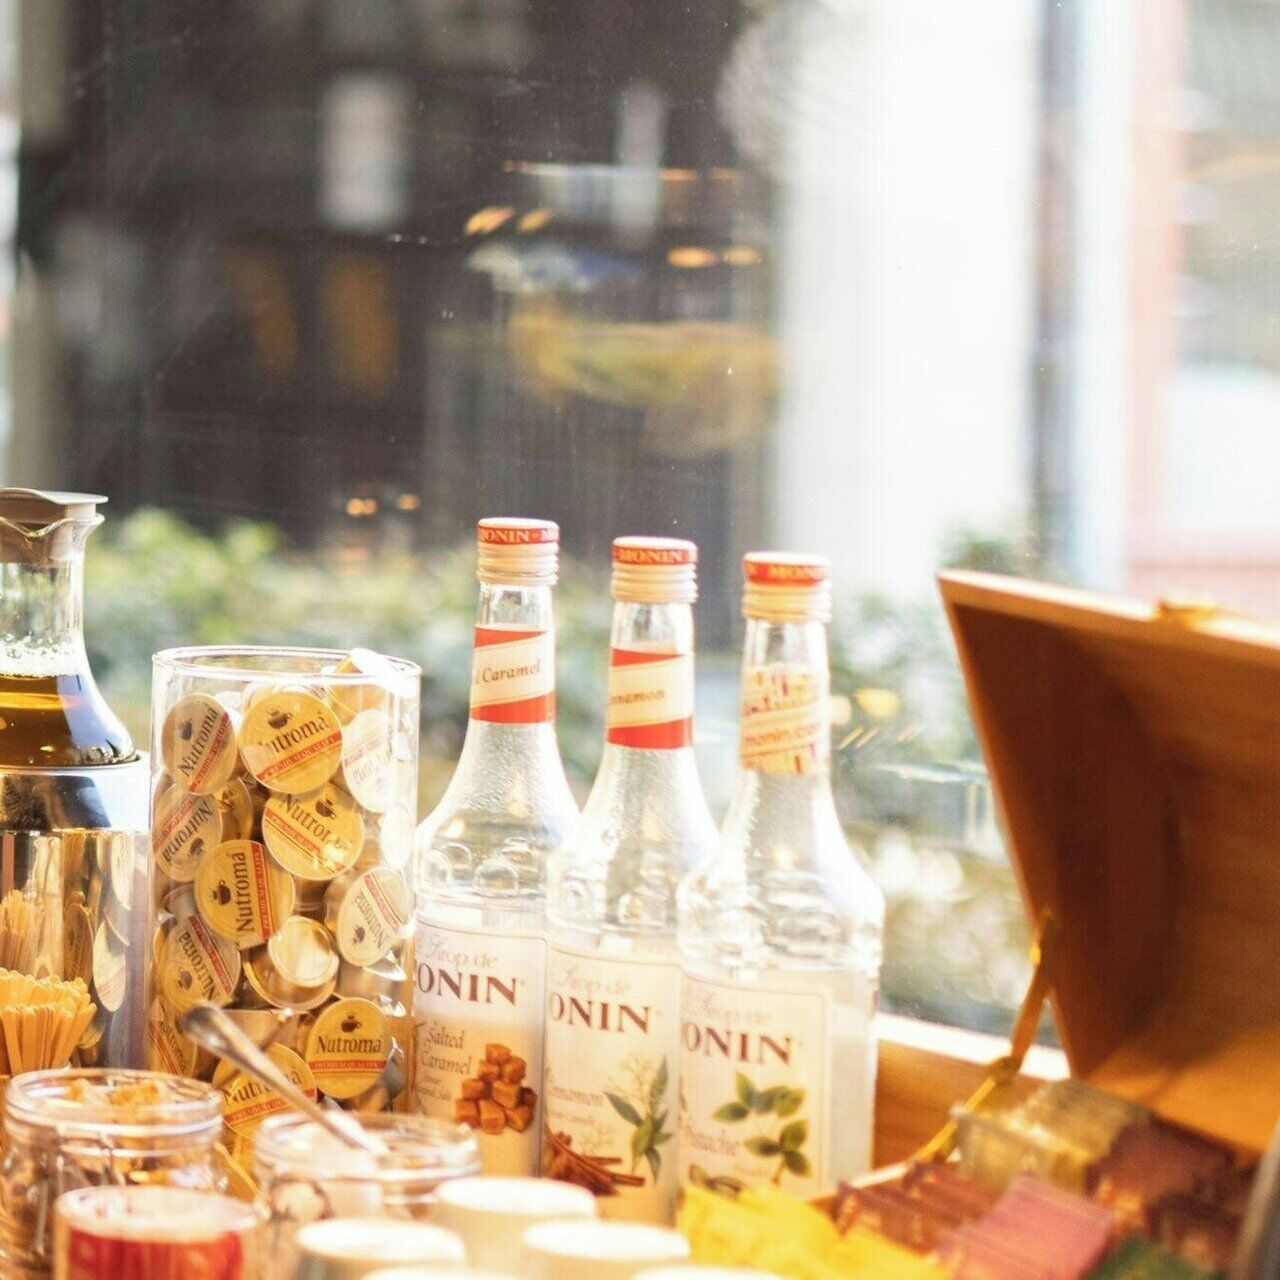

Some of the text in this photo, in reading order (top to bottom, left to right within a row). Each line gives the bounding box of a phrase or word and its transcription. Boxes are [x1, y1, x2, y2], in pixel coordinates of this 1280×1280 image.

[482, 658, 541, 684] Caramel
[177, 706, 219, 778] Nutroma
[257, 712, 330, 753] utroma
[161, 800, 213, 863] Nutroma
[234, 851, 255, 933] Nutroma
[178, 930, 218, 999] Nutroma
[416, 962, 519, 1007] ONIN
[548, 991, 650, 1034] ONIN
[316, 1034, 382, 1054] Nutroma
[426, 1023, 466, 1050] Salted
[682, 1020, 792, 1067] ONIN
[420, 1044, 473, 1075] Caramel
